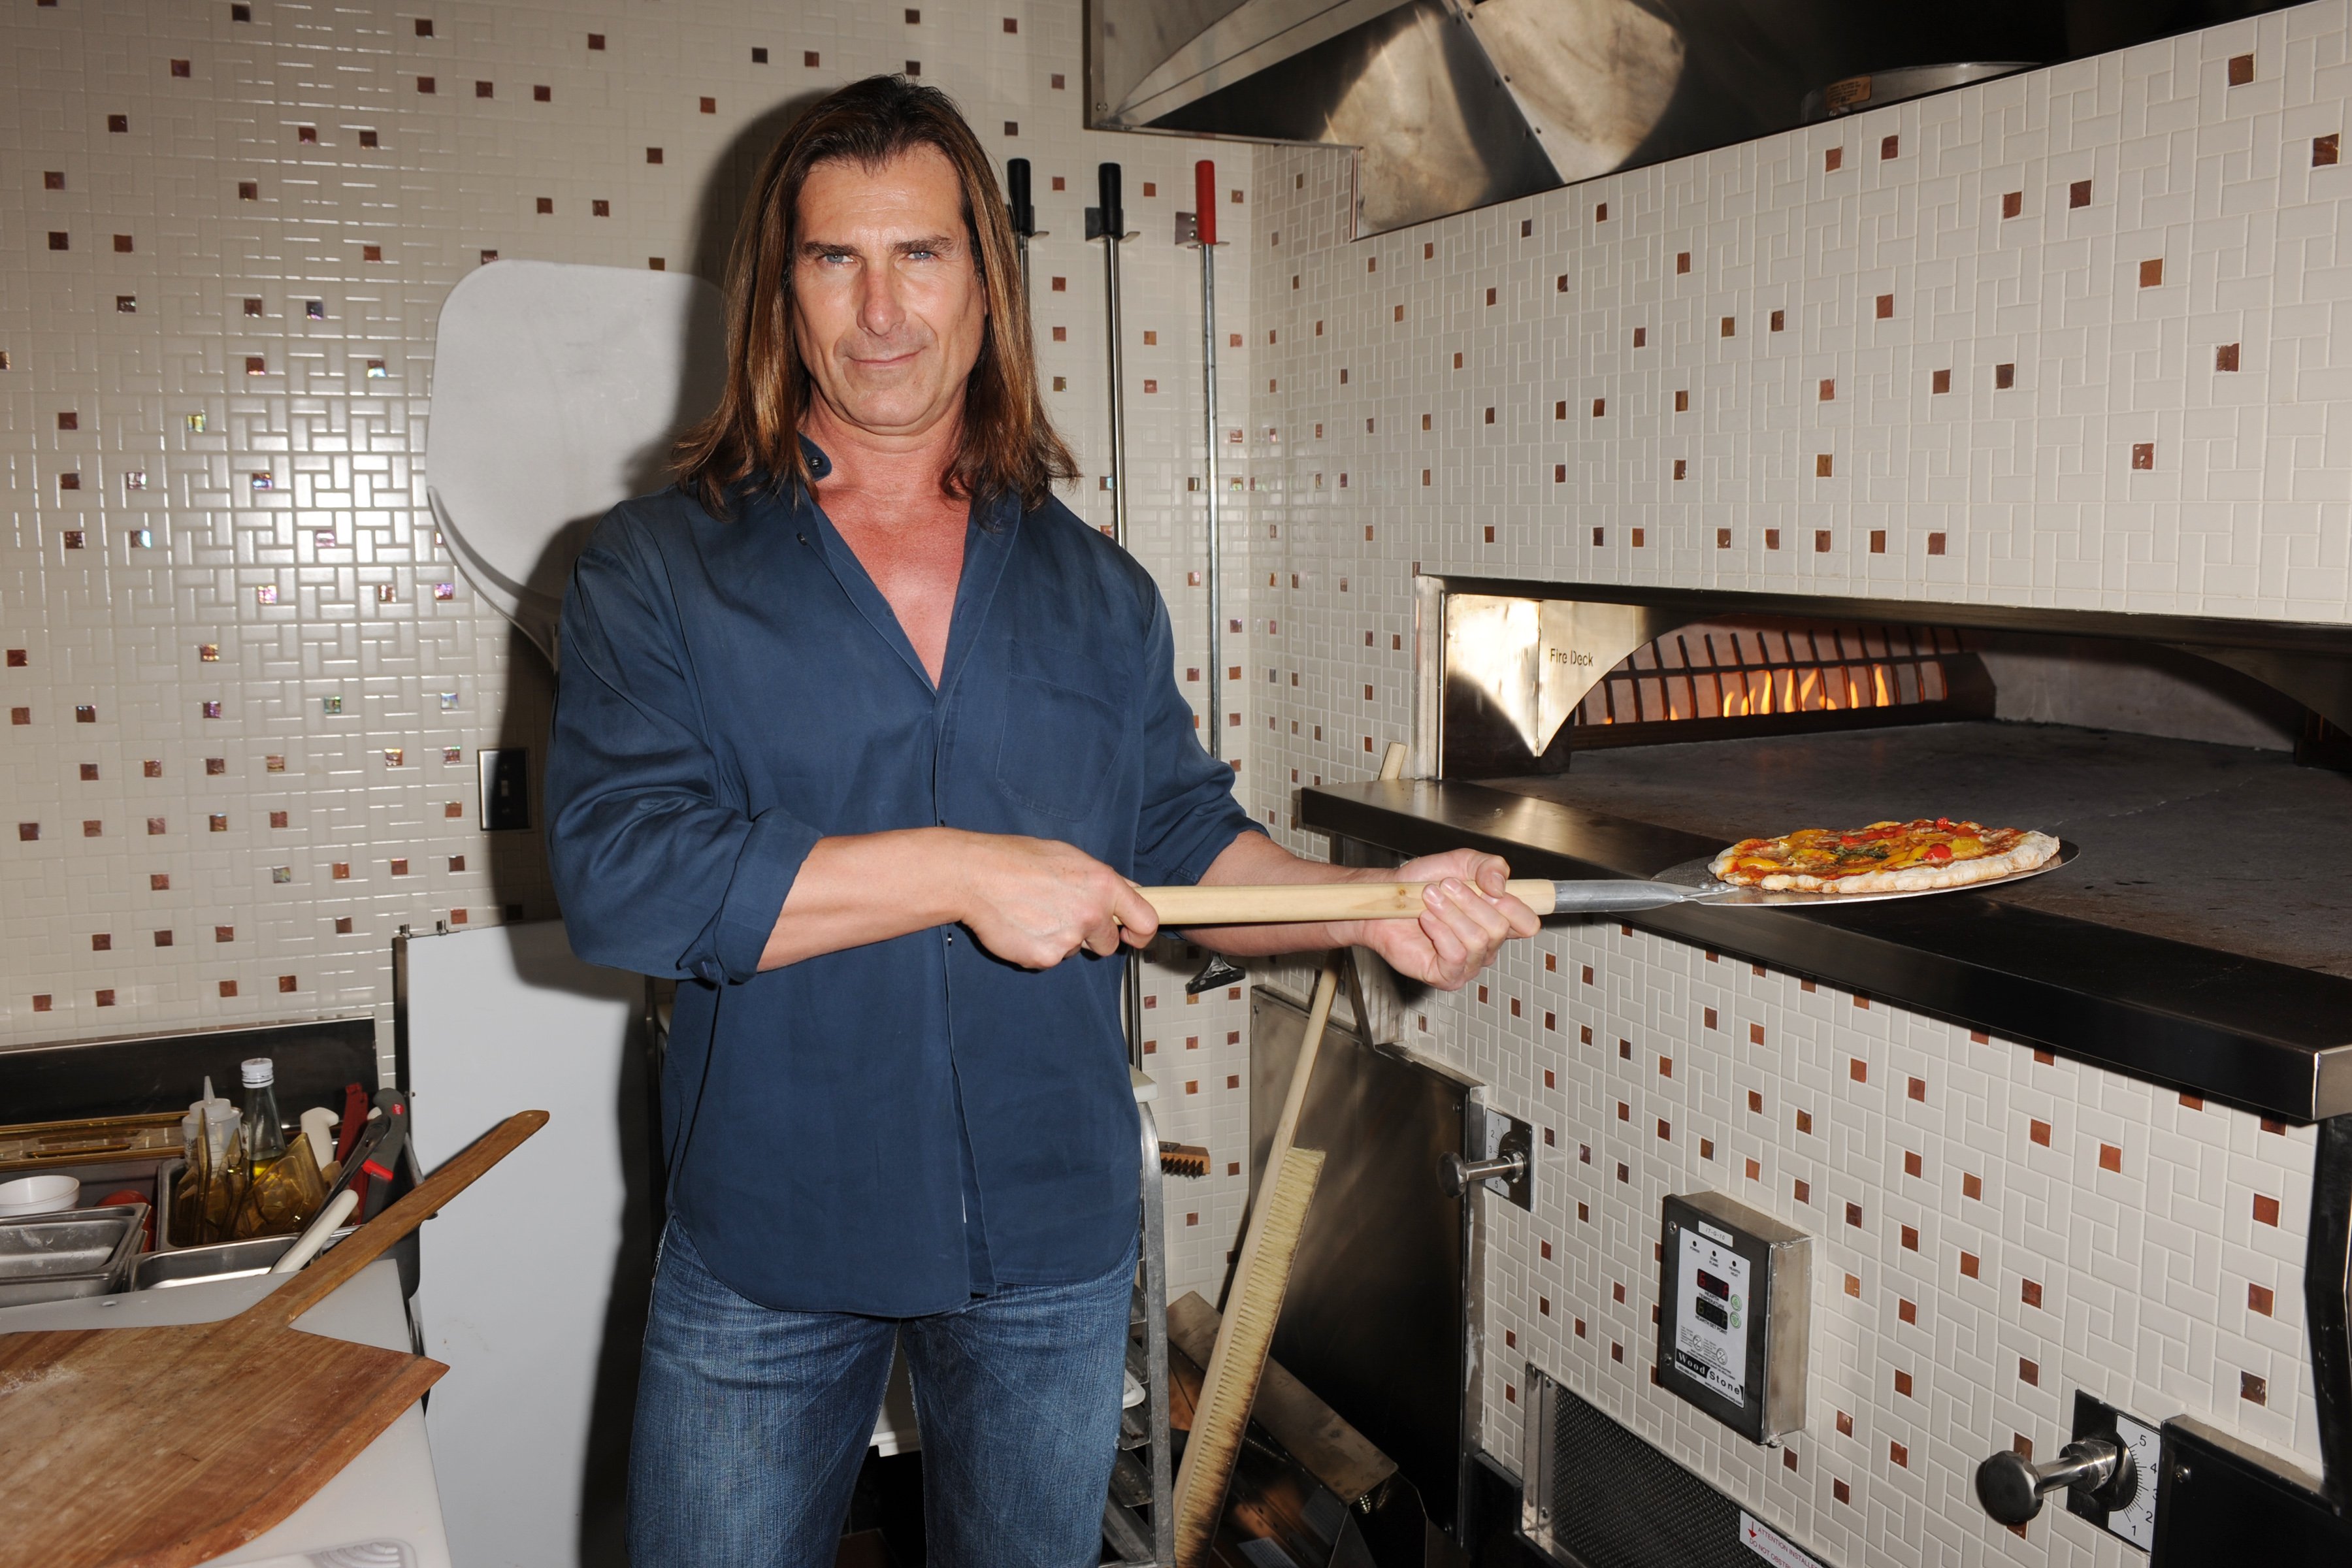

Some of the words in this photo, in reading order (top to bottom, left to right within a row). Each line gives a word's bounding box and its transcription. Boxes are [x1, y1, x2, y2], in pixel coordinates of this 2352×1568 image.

[1550, 648, 1567, 664] Fire
[1570, 649, 1593, 666] Deck
[1491, 1130, 1495, 1138] 2
[1488, 1145, 1492, 1154] 3
[1495, 1180, 1499, 1188] 5
[1699, 1292, 1725, 1310] TEMPERATURE
[1705, 1291, 1720, 1301] HEARTH
[1695, 1315, 1709, 1326] HEARTH
[1716, 1326, 1728, 1335] POINT
[1678, 1352, 1705, 1375] Wood
[1709, 1371, 1740, 1395] Stone
[2139, 1434, 2147, 1447] 5
[2150, 1463, 2157, 1474] 4
[2146, 1511, 2153, 1524] 2
[2131, 1526, 2136, 1536] 1
[1757, 1527, 1788, 1553] ATTENTION
[1749, 1538, 1757, 1547] DO
[1758, 1544, 1770, 1556] NOT
